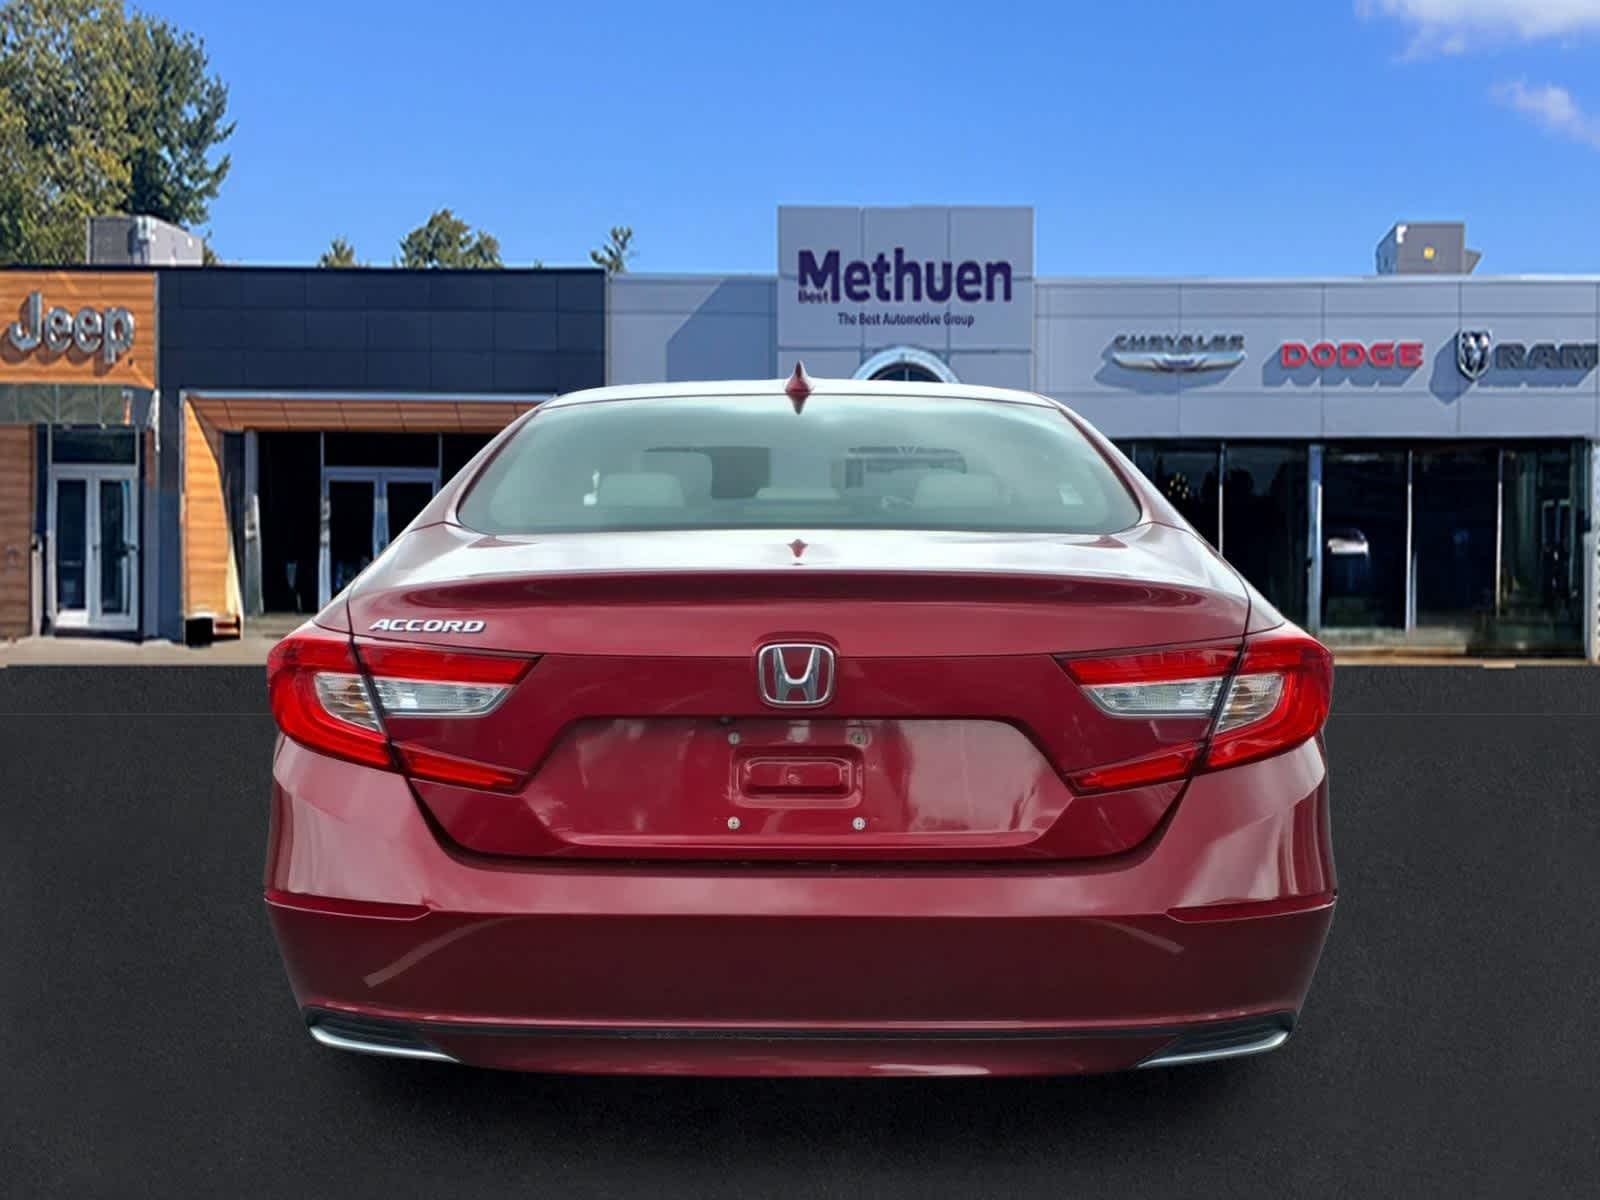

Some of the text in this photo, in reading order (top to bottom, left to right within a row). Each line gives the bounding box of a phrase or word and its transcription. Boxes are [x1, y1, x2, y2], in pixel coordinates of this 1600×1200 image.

[798, 247, 1012, 303] Methuen
[798, 289, 829, 304] Best
[9, 291, 135, 364] Jeep
[838, 312, 975, 329] The Best Automotive Group
[1113, 334, 1245, 352] CHRYSLER
[1281, 342, 1424, 368] DODGE
[1495, 343, 1599, 369] RAM
[368, 618, 486, 633] ACCORD
